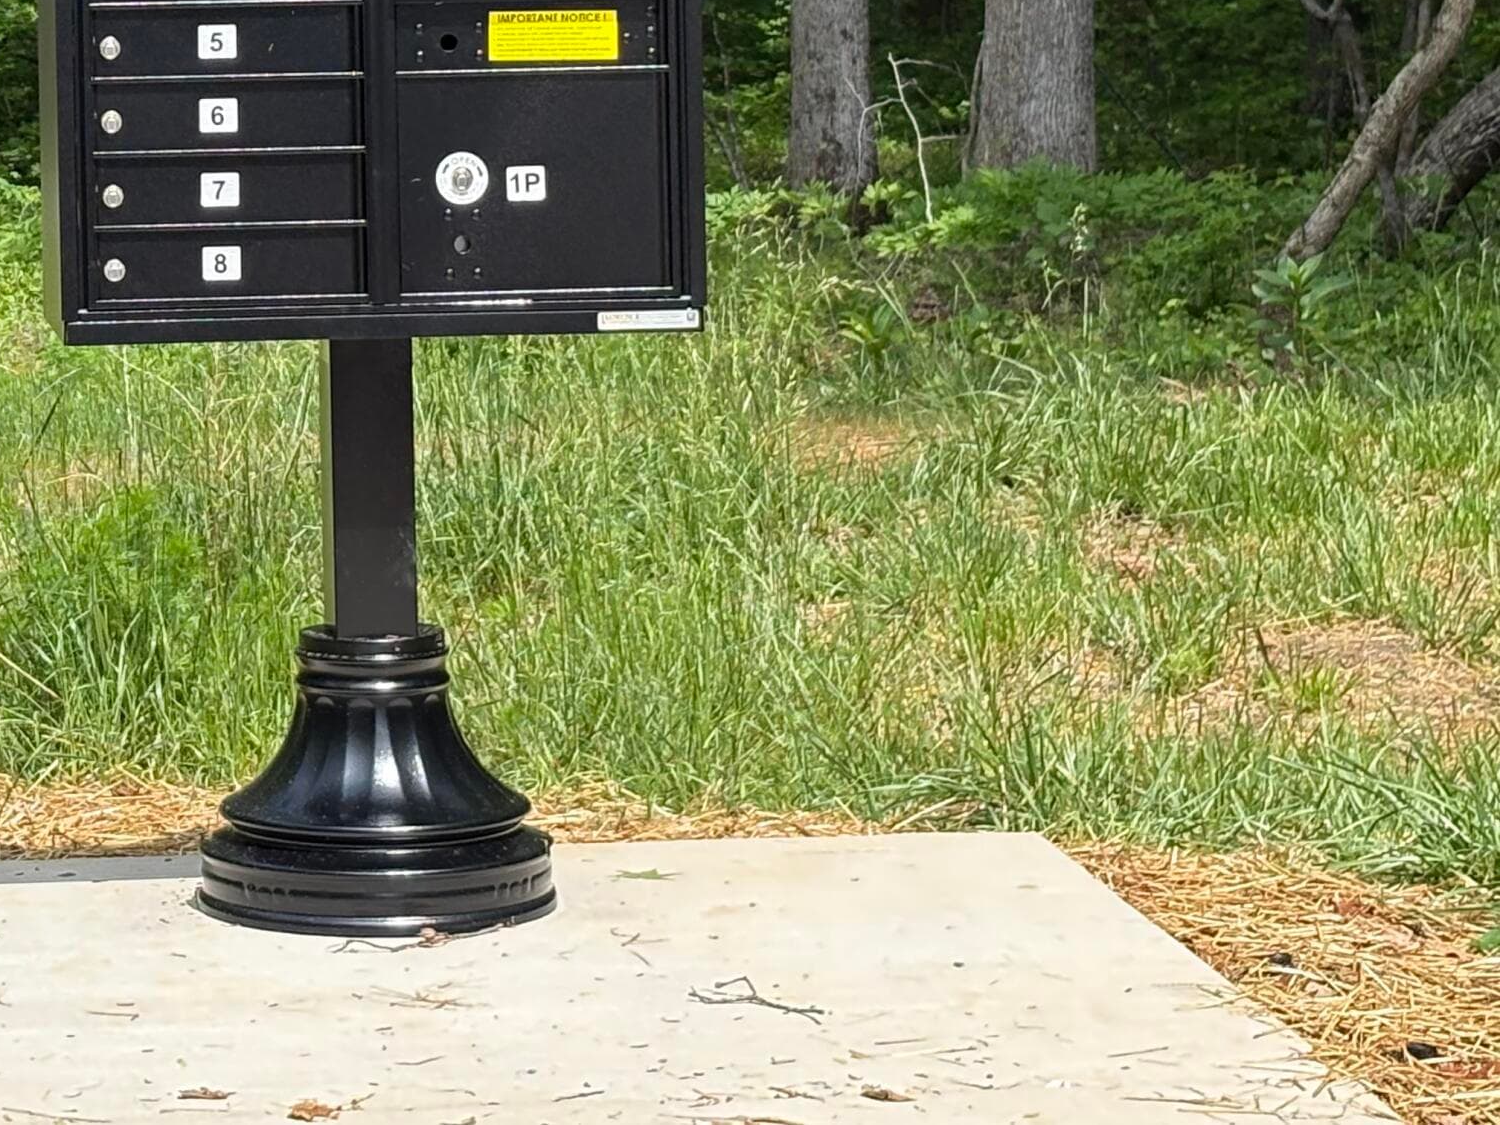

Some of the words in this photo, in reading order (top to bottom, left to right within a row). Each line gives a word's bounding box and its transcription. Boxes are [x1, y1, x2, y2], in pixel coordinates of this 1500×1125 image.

[497, 13, 558, 24] IMPORTANT
[210, 32, 223, 52] 5
[211, 106, 224, 125] 6
[212, 180, 225, 200] 7
[510, 173, 540, 193] 1P
[214, 253, 227, 273] 8
